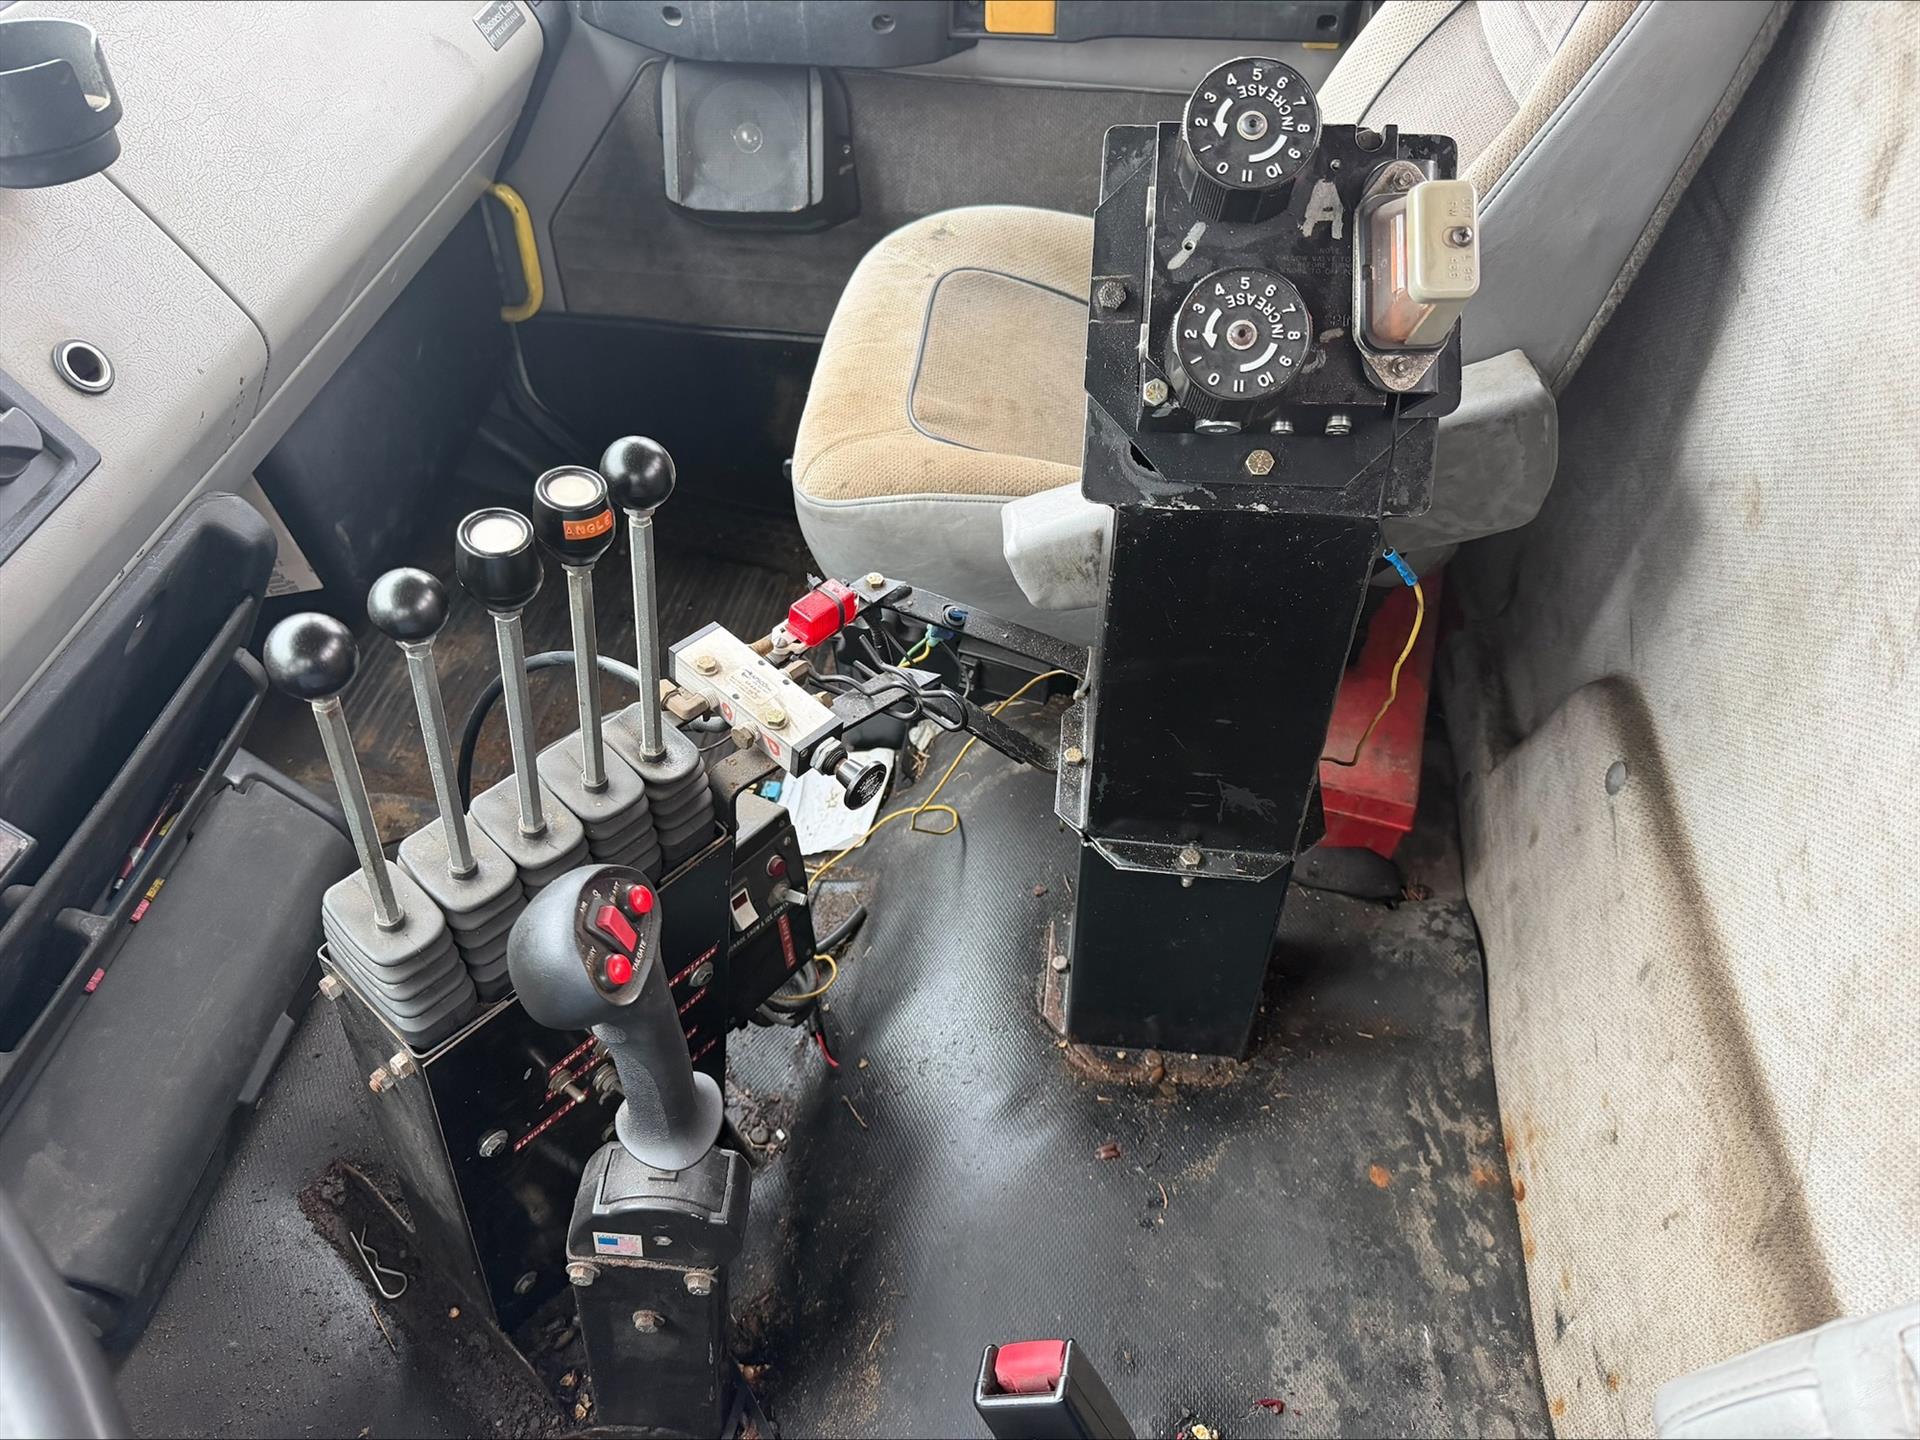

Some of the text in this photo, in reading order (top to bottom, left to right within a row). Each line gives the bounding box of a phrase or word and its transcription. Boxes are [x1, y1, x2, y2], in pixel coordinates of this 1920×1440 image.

[1226, 73, 1237, 86] 4
[1252, 68, 1262, 81] 5
[1276, 76, 1289, 89] 6
[1204, 92, 1217, 104] 3
[1293, 97, 1307, 106] 7
[1237, 84, 1294, 131] INCREASE
[1195, 117, 1208, 127] 2
[1297, 124, 1310, 133] 8
[1241, 169, 1253, 182] 11
[1266, 163, 1283, 178] 10
[1214, 283, 1225, 295] 4
[1240, 277, 1250, 289] 5
[1264, 284, 1277, 297] 6
[1192, 303, 1205, 314] 3
[1282, 303, 1297, 314] 7
[1225, 293, 1284, 339] INCREASE
[1184, 329, 1198, 339] 2
[1287, 331, 1301, 340] 8
[1233, 379, 1244, 392] 11
[1257, 371, 1274, 387] 10
[566, 516, 612, 535] ANGLE
[558, 1088, 588, 1116] LIGT
